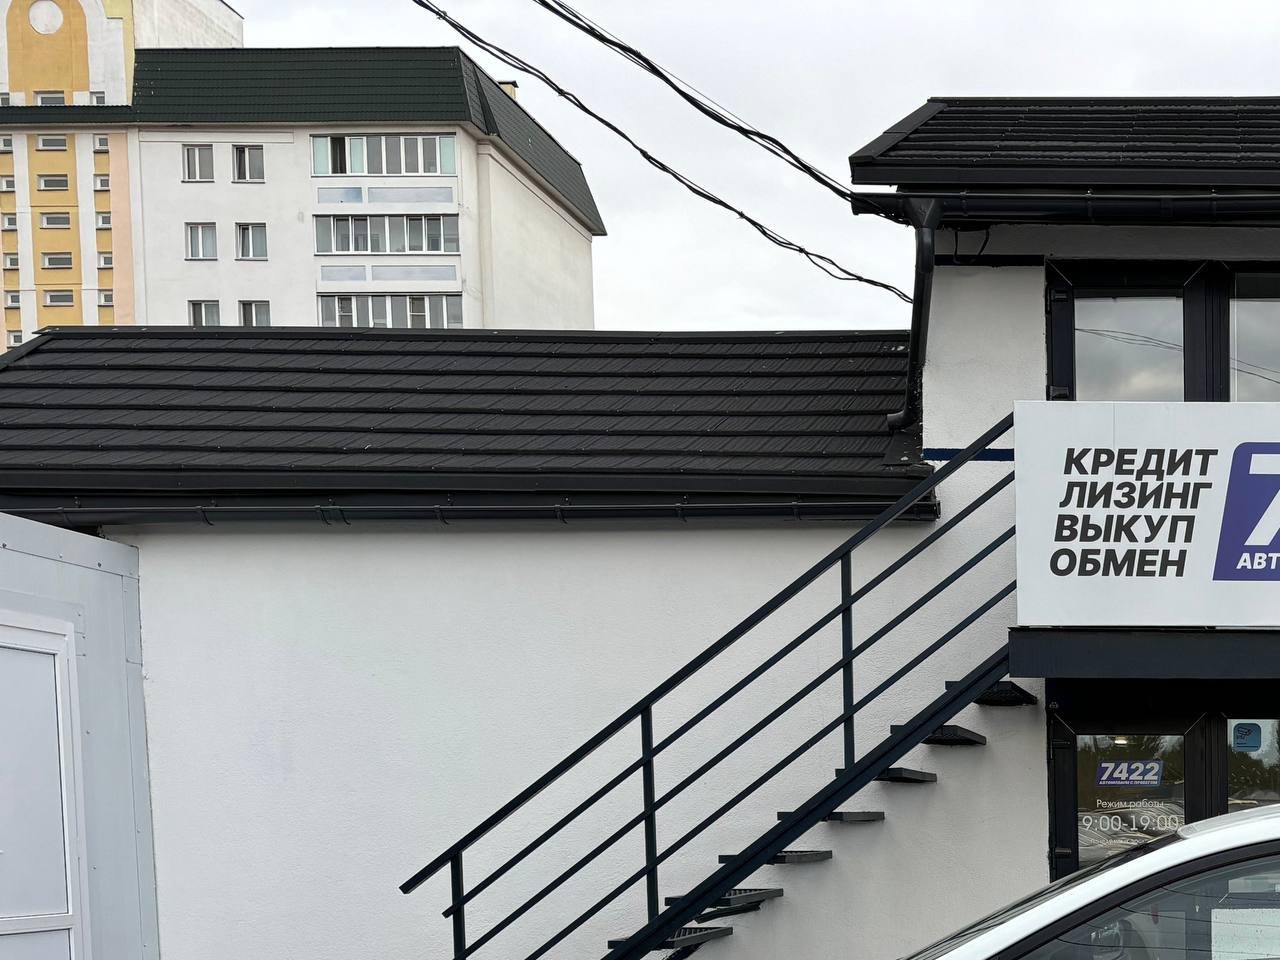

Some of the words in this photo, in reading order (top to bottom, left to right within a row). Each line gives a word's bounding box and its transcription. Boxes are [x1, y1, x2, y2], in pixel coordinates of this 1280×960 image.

[1064, 448, 1218, 480] КРЕДИТ
[1059, 481, 1212, 509] ЛИЗИНГ
[1054, 515, 1195, 542] ВЫКУП
[1050, 549, 1187, 577] ОБМЕН
[1100, 762, 1160, 781] 7422
[1096, 799, 1127, 808] Режим
[1082, 815, 1179, 831] 9:00-19:00
